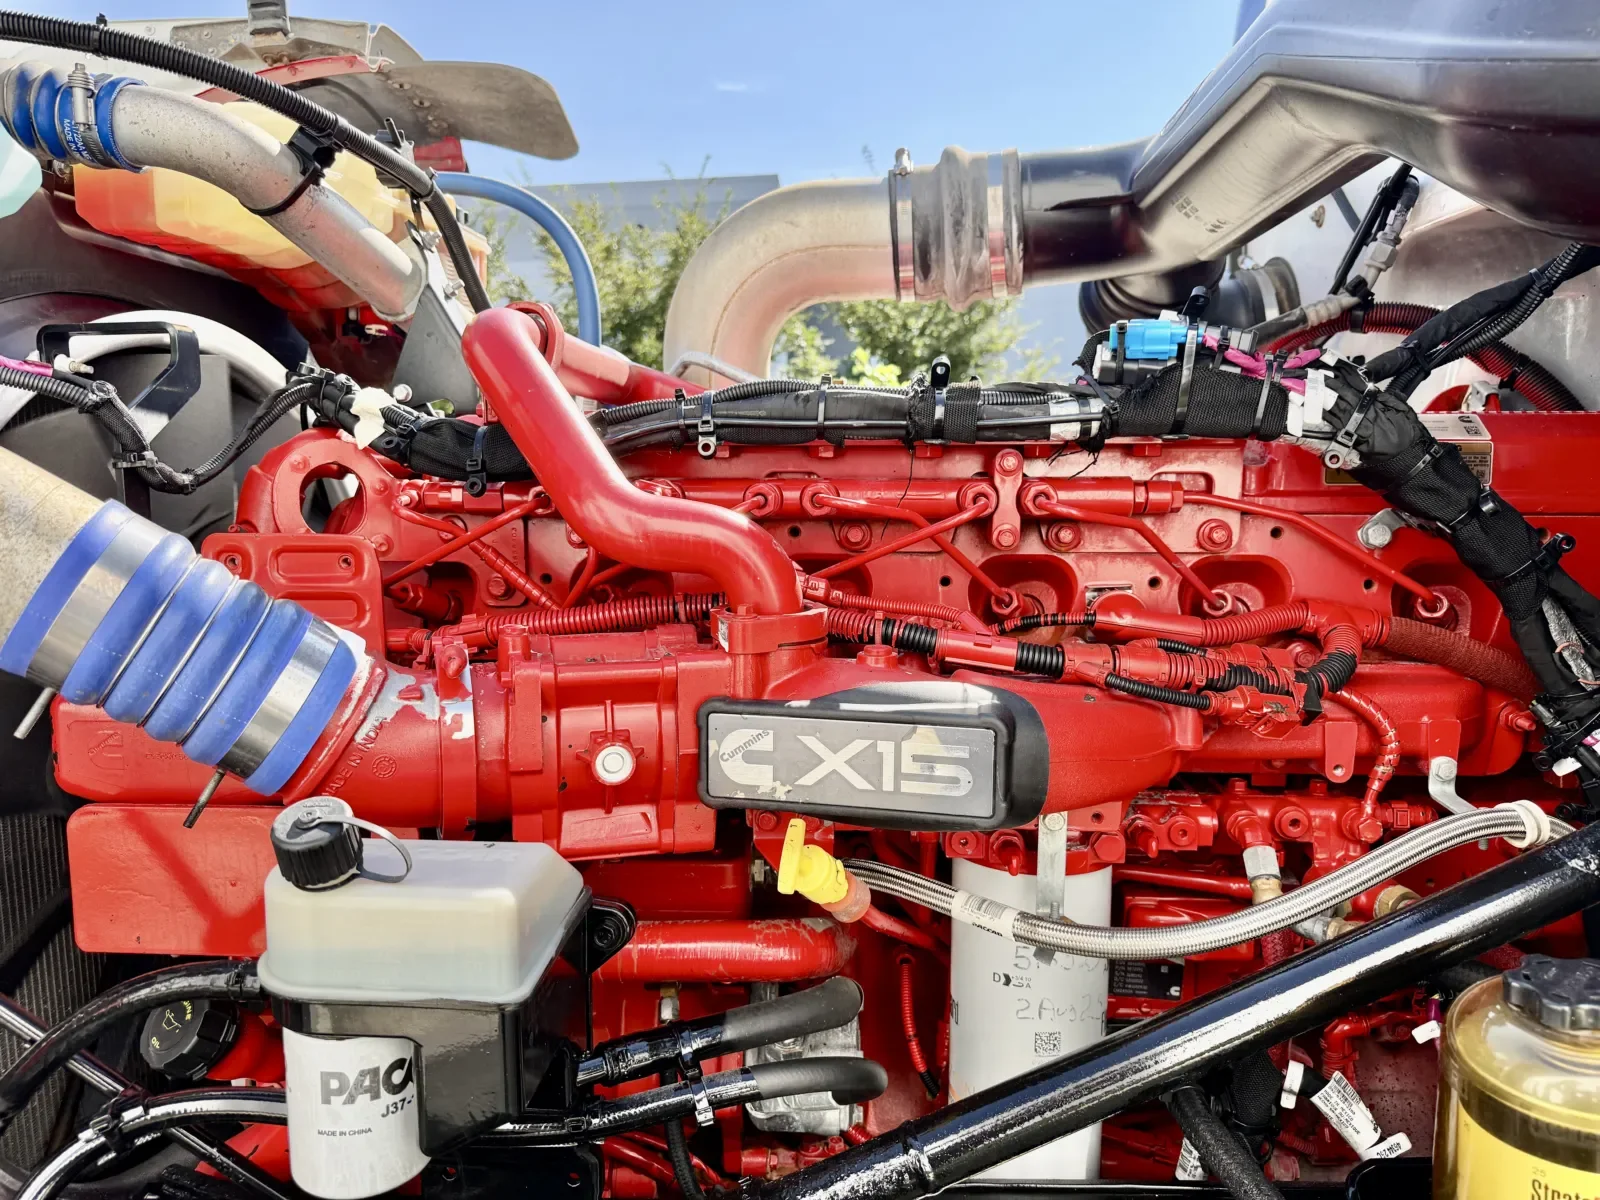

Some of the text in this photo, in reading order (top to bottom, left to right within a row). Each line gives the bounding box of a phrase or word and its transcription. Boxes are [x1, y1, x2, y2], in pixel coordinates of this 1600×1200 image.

[347, 751, 364, 768] IN
[357, 715, 388, 753] INDIA
[719, 728, 770, 763] Cummins
[793, 735, 974, 797] X15
[151, 1036, 160, 1049] OIL
[317, 1128, 338, 1137] MADE
[347, 1127, 373, 1137] CHINA
